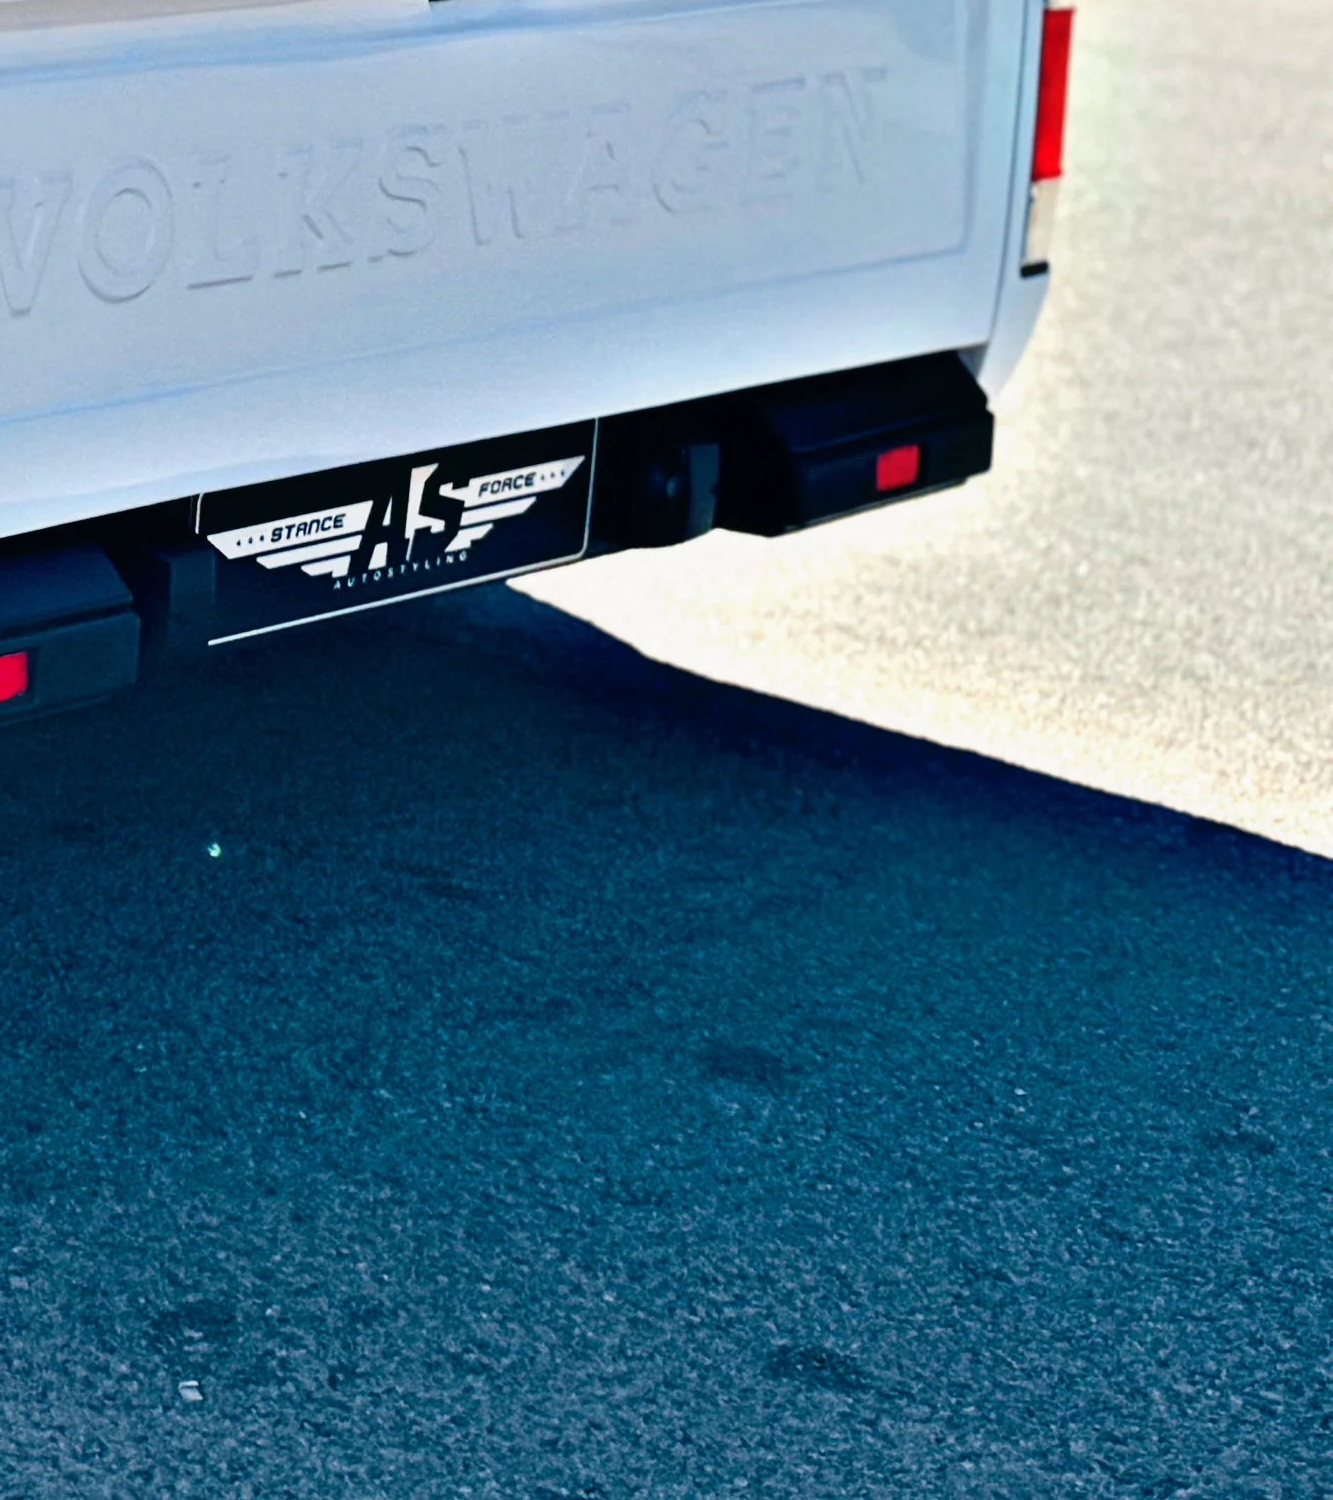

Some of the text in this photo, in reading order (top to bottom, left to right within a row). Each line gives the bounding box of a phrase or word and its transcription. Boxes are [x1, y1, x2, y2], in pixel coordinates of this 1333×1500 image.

[478, 471, 538, 499] FORCE
[270, 512, 347, 544] STANCE
[333, 551, 467, 590] AUTOSTYLING
